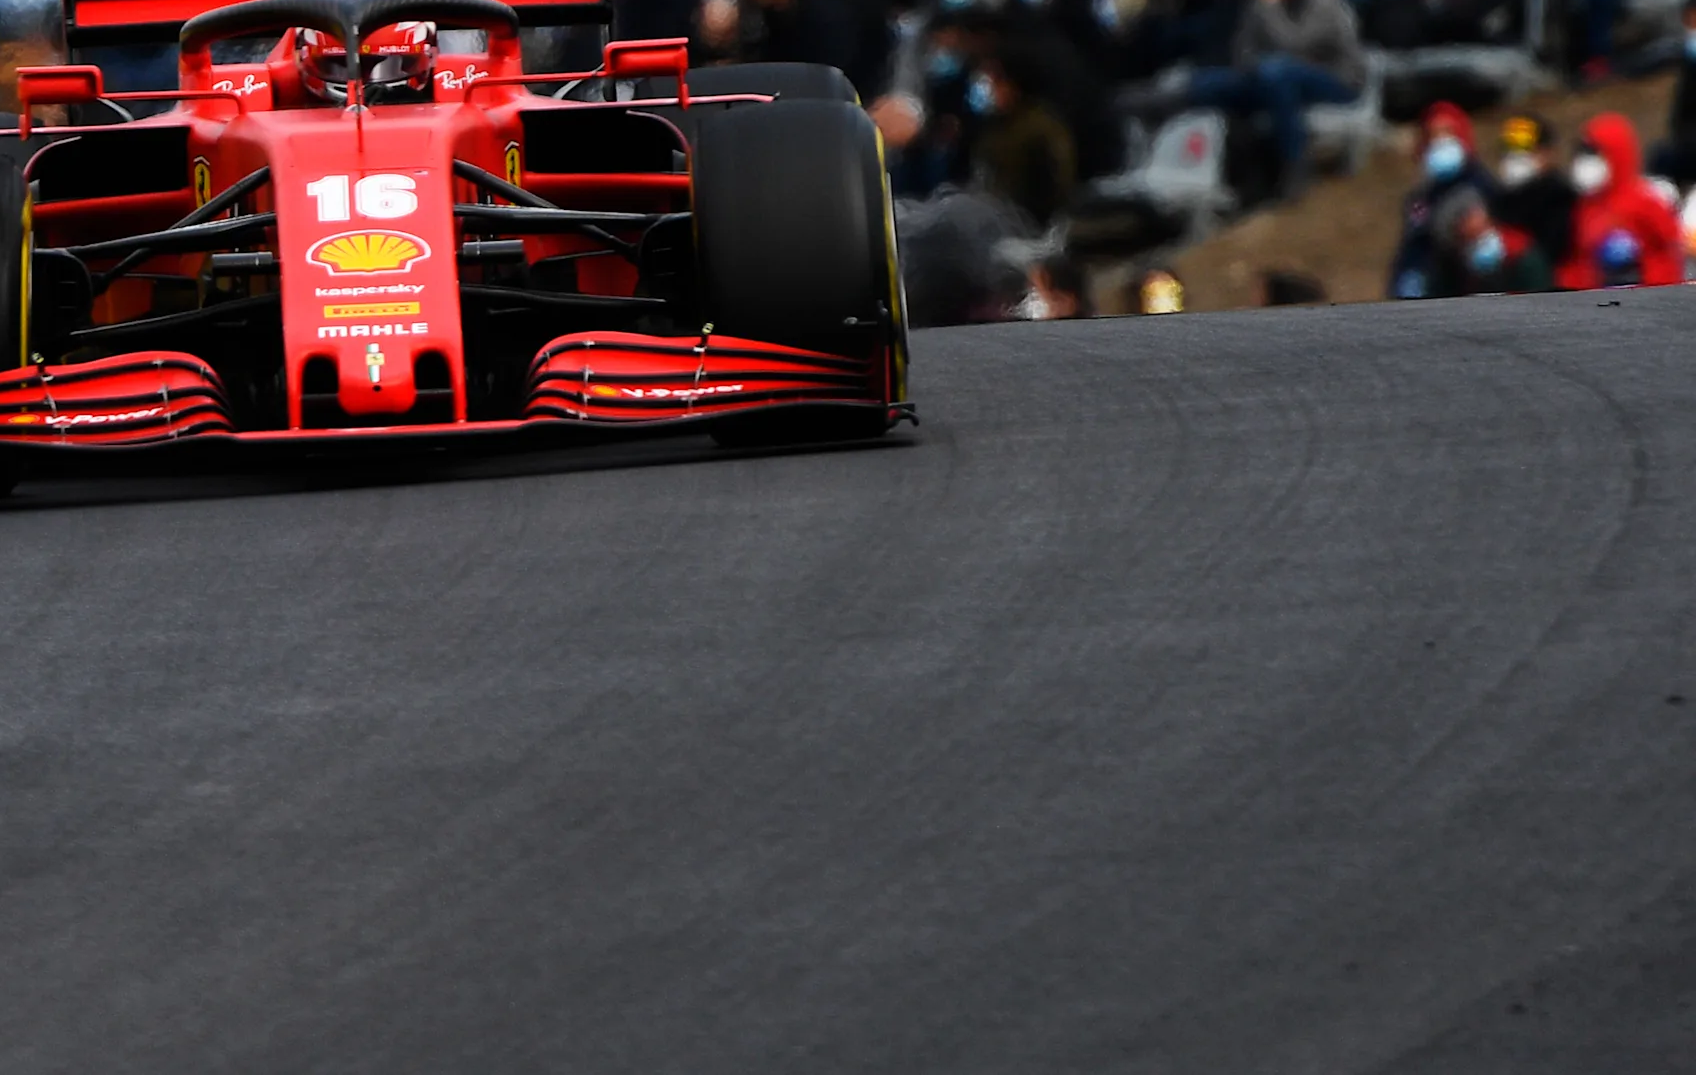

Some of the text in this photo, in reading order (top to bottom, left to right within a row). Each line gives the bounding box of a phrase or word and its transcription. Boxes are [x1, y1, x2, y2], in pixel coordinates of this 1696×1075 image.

[433, 64, 489, 89] Ray-Ban
[307, 173, 418, 221] 16
[315, 283, 425, 297] kaspersky
[317, 322, 429, 338] MAHLE
[45, 407, 164, 424] V-Power
